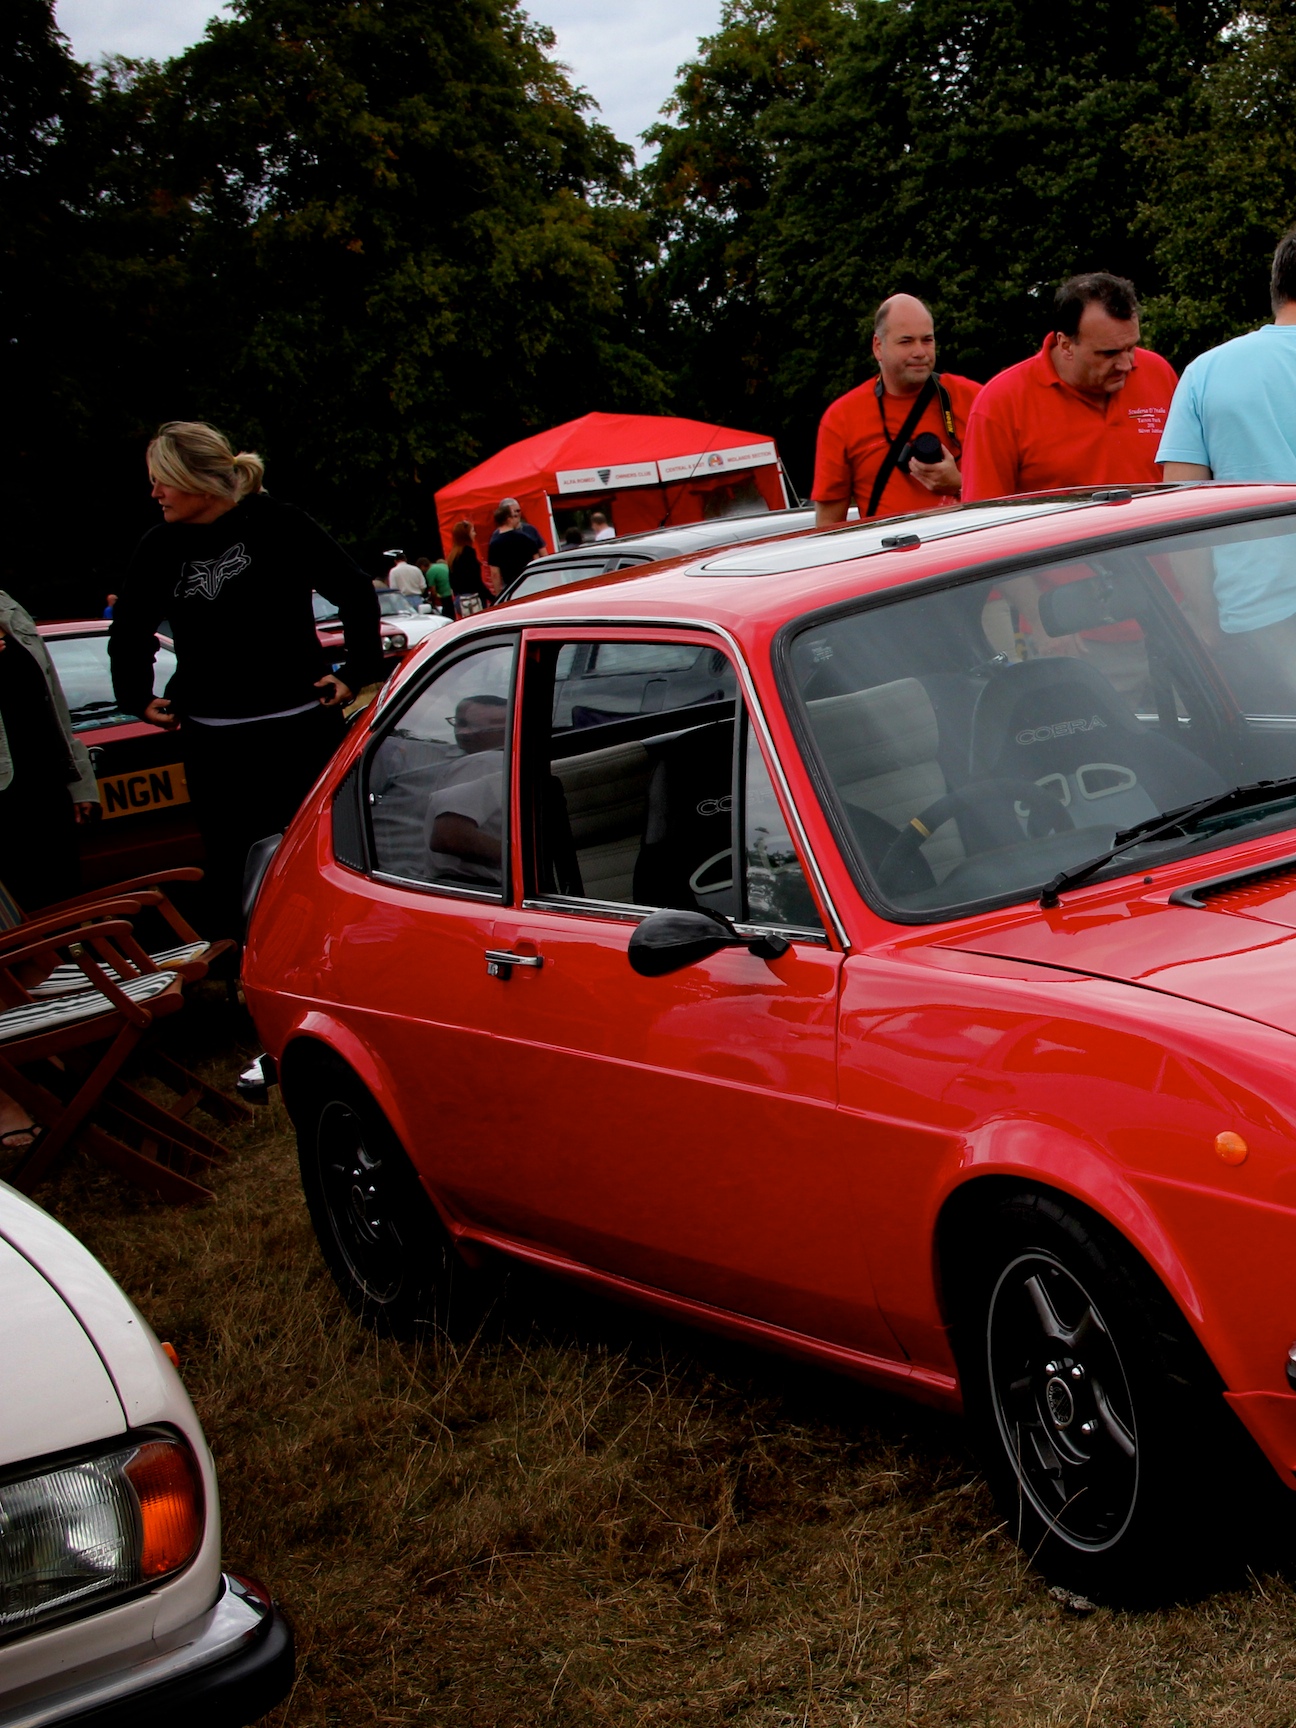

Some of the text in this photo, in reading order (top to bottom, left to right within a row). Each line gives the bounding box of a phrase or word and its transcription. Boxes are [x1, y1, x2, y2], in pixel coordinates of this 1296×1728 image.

[727, 451, 772, 463] MIDLANDS SECTION
[665, 463, 688, 473] CENTRAL
[577, 476, 596, 484] ROMEO
[1016, 715, 1107, 745] COBRA
[103, 770, 174, 812] NGN
